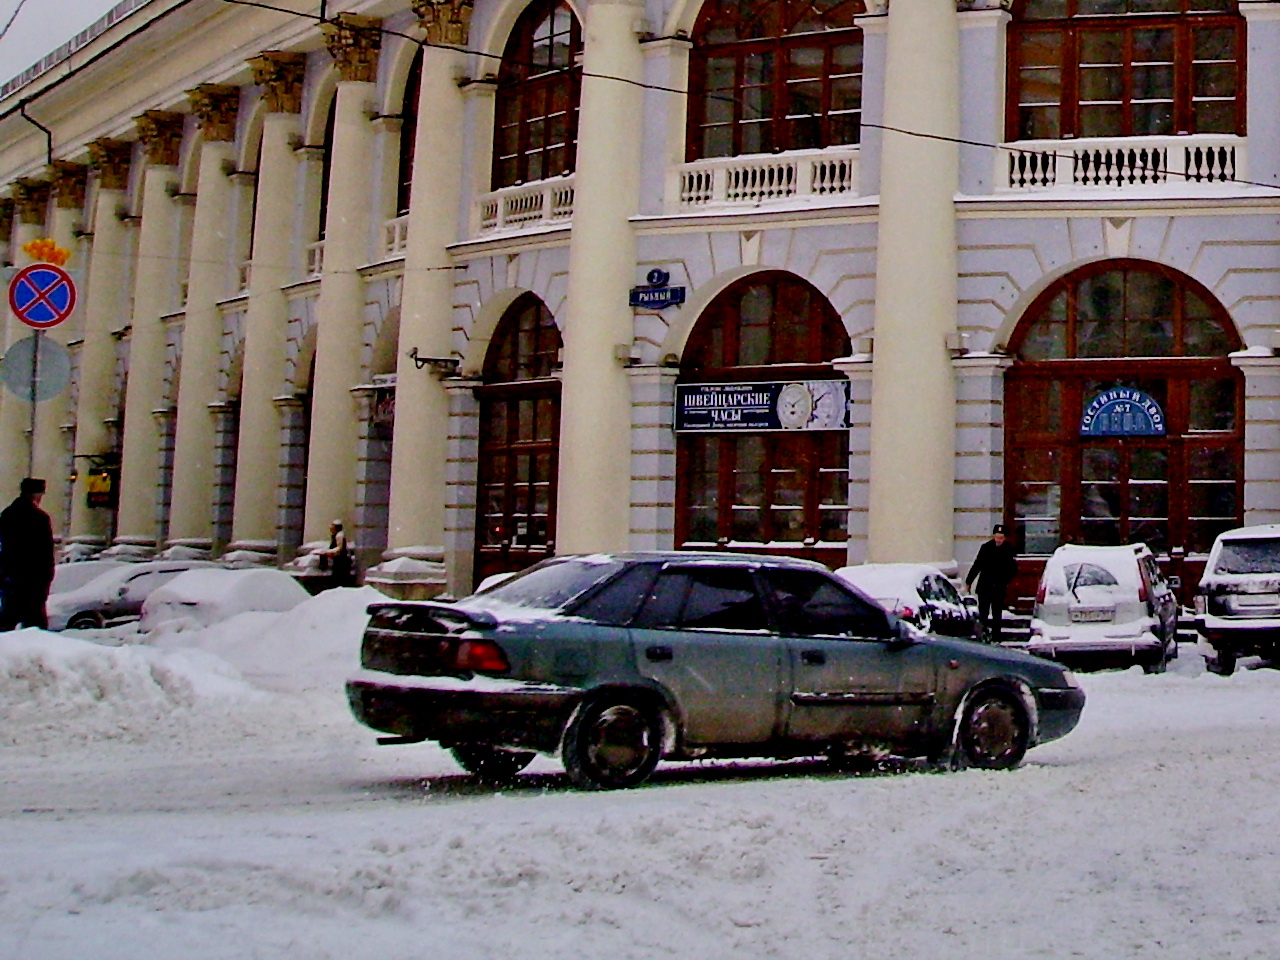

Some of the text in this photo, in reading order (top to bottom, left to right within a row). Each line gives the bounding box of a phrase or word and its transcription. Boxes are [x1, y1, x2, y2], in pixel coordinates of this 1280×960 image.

[684, 392, 771, 407] ШВЕЙЦАРСКИЕ
[711, 409, 742, 422] ЧАСЫ
[1081, 390, 1163, 431] ГОСТИНЫЙ ДВОР
